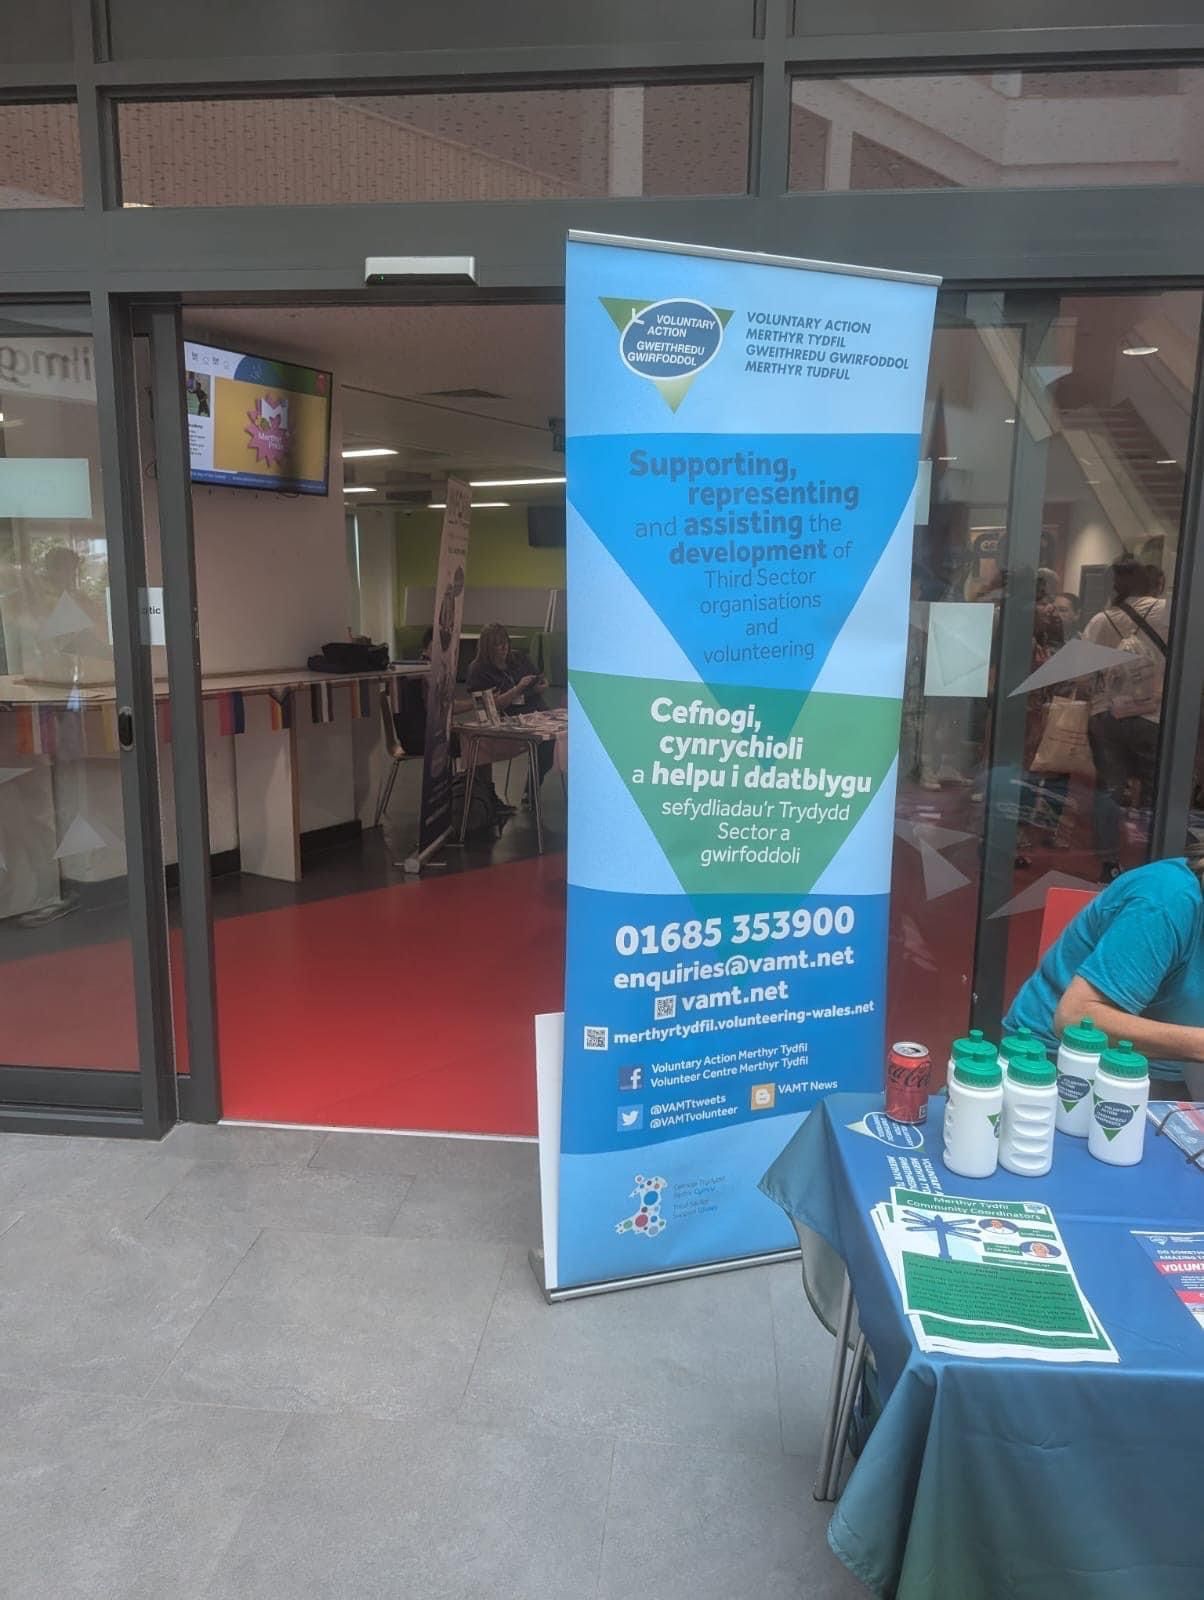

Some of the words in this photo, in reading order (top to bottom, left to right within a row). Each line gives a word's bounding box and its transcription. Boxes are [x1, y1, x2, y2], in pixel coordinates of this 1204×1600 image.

[647, 326, 687, 338] ACTION
[656, 314, 715, 331] VOLUNTARY
[747, 312, 821, 329] VOLUNTARY
[824, 318, 872, 334] ACTION
[636, 341, 705, 356] GWEITHREDU
[746, 328, 804, 345] MERTHYR
[807, 334, 846, 348] TYDFIL
[628, 351, 697, 367] GWIRFODDOL
[746, 344, 827, 362] GWEITHREDU
[829, 352, 909, 369] GWIRFODDOL
[745, 360, 803, 376] MERTHYR
[806, 366, 850, 380] TUDFUL
[629, 450, 798, 482] Supporting,
[688, 480, 860, 512] representing
[635, 516, 677, 538] and
[684, 510, 803, 540] assisting
[809, 514, 842, 533] the
[669, 539, 828, 568] development
[833, 541, 854, 559] of
[704, 569, 751, 588] Third
[756, 568, 817, 587] Sector
[700, 592, 822, 618] organisations
[745, 618, 779, 636] and
[703, 640, 815, 664] volunteering
[651, 697, 762, 734] Cefnogi,
[659, 734, 804, 763] cynrychioli
[631, 767, 645, 785] a
[651, 761, 726, 793] helpu
[732, 764, 740, 788] i
[744, 765, 872, 799] ddatblygu
[661, 798, 775, 821] sefydliadau'r
[779, 801, 850, 825] Trydydd
[717, 822, 777, 841] Sector
[780, 828, 791, 841] a
[700, 845, 801, 867] gwirfoddoli
[615, 918, 722, 956] 01685
[731, 906, 855, 945] 353900
[613, 946, 855, 992] enquiries@vamt.net
[681, 980, 789, 1011] vamt.net
[613, 1000, 875, 1045] merthyrtydfil.volunteering-wales.net
[651, 1058, 702, 1074] Voluntary
[704, 1052, 737, 1066] Action
[738, 1045, 779, 1063] Merthyr
[780, 1043, 808, 1057] Tydfil
[650, 1073, 700, 1088] Volunteer
[703, 1067, 738, 1080] Centre
[739, 1059, 779, 1077] Merthyr
[781, 1056, 809, 1071] Tydfil
[778, 1082, 809, 1094] VAMT
[811, 1080, 838, 1091] News
[650, 1094, 727, 1116] @VAMTtweets
[650, 1106, 738, 1129] @VAMTvolunteer
[906, 1199, 969, 1214] Community
[970, 1208, 1041, 1220] Coordinators
[933, 1196, 977, 1208] Merthyr
